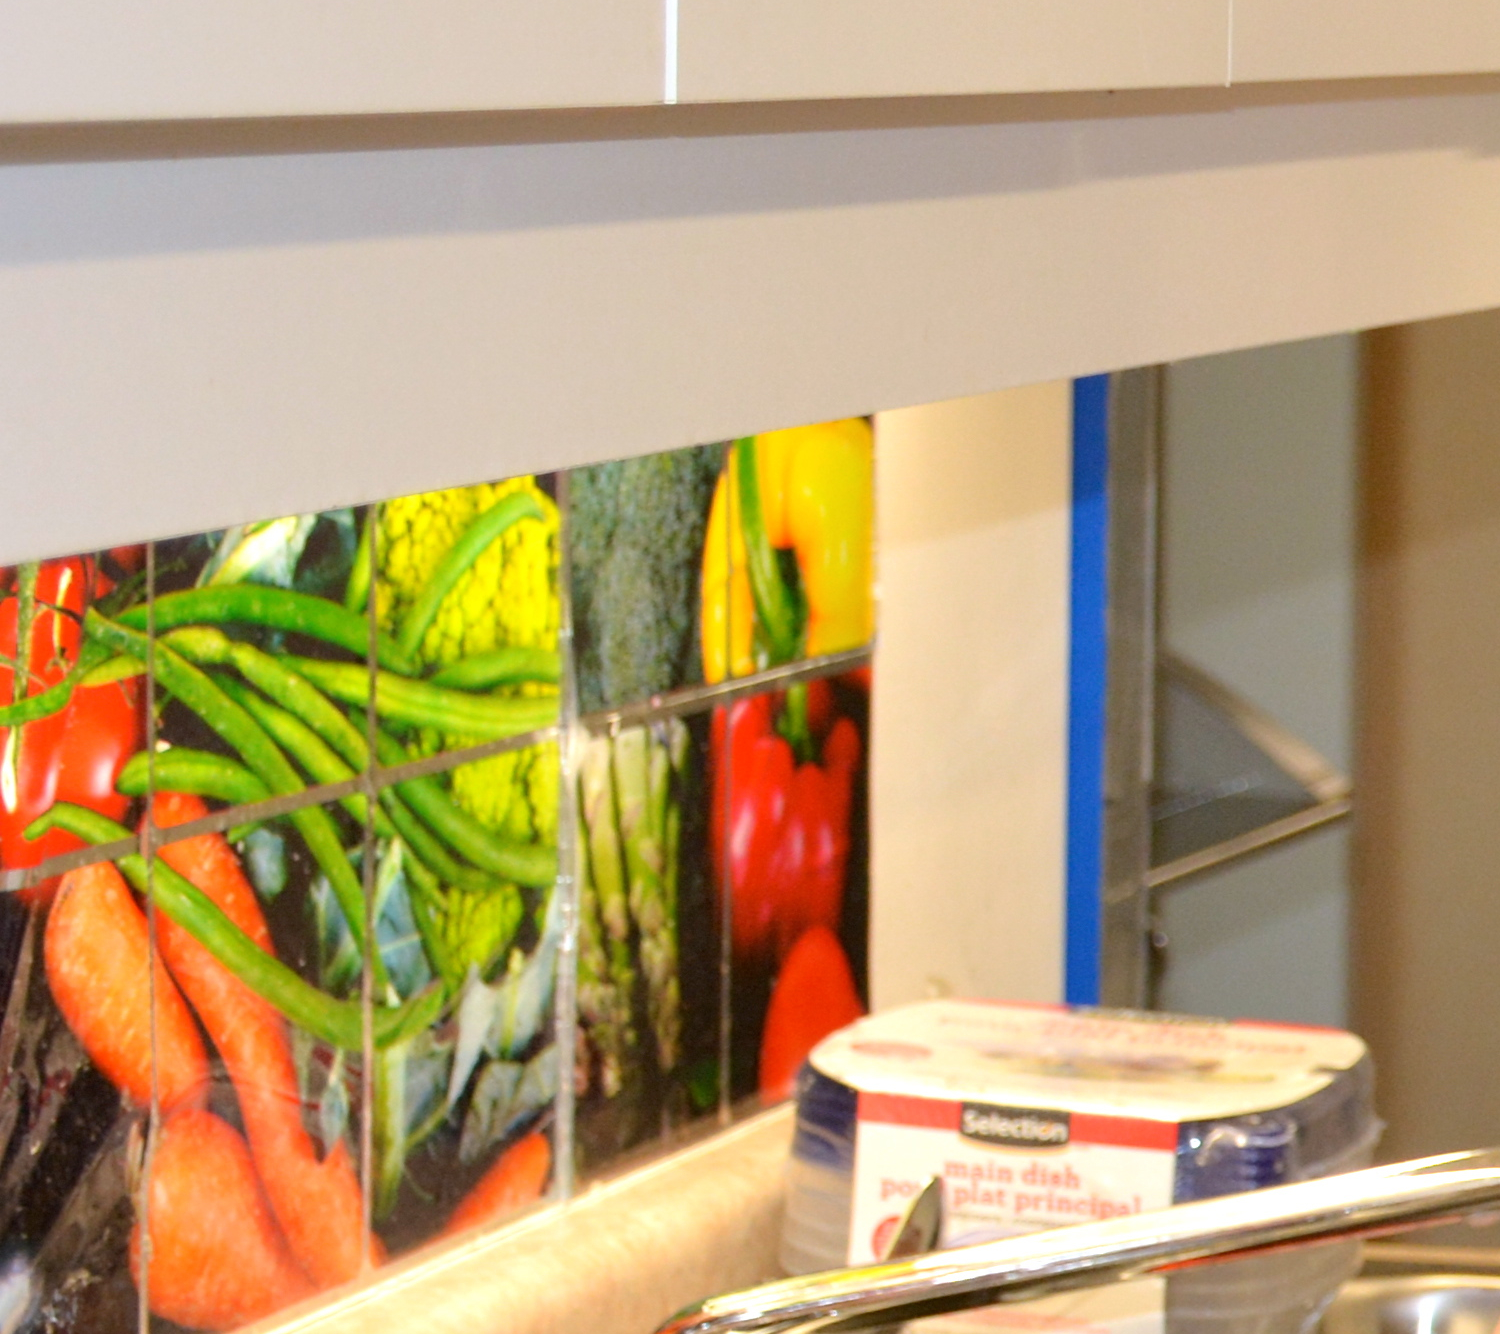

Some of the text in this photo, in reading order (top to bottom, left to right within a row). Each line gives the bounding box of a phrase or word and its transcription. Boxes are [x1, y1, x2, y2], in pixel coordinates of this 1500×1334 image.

[961, 1109, 1068, 1142] Selection
[944, 1159, 1081, 1190] main dish
[952, 1177, 1005, 1208] plat
[1014, 1188, 1142, 1217] principal
